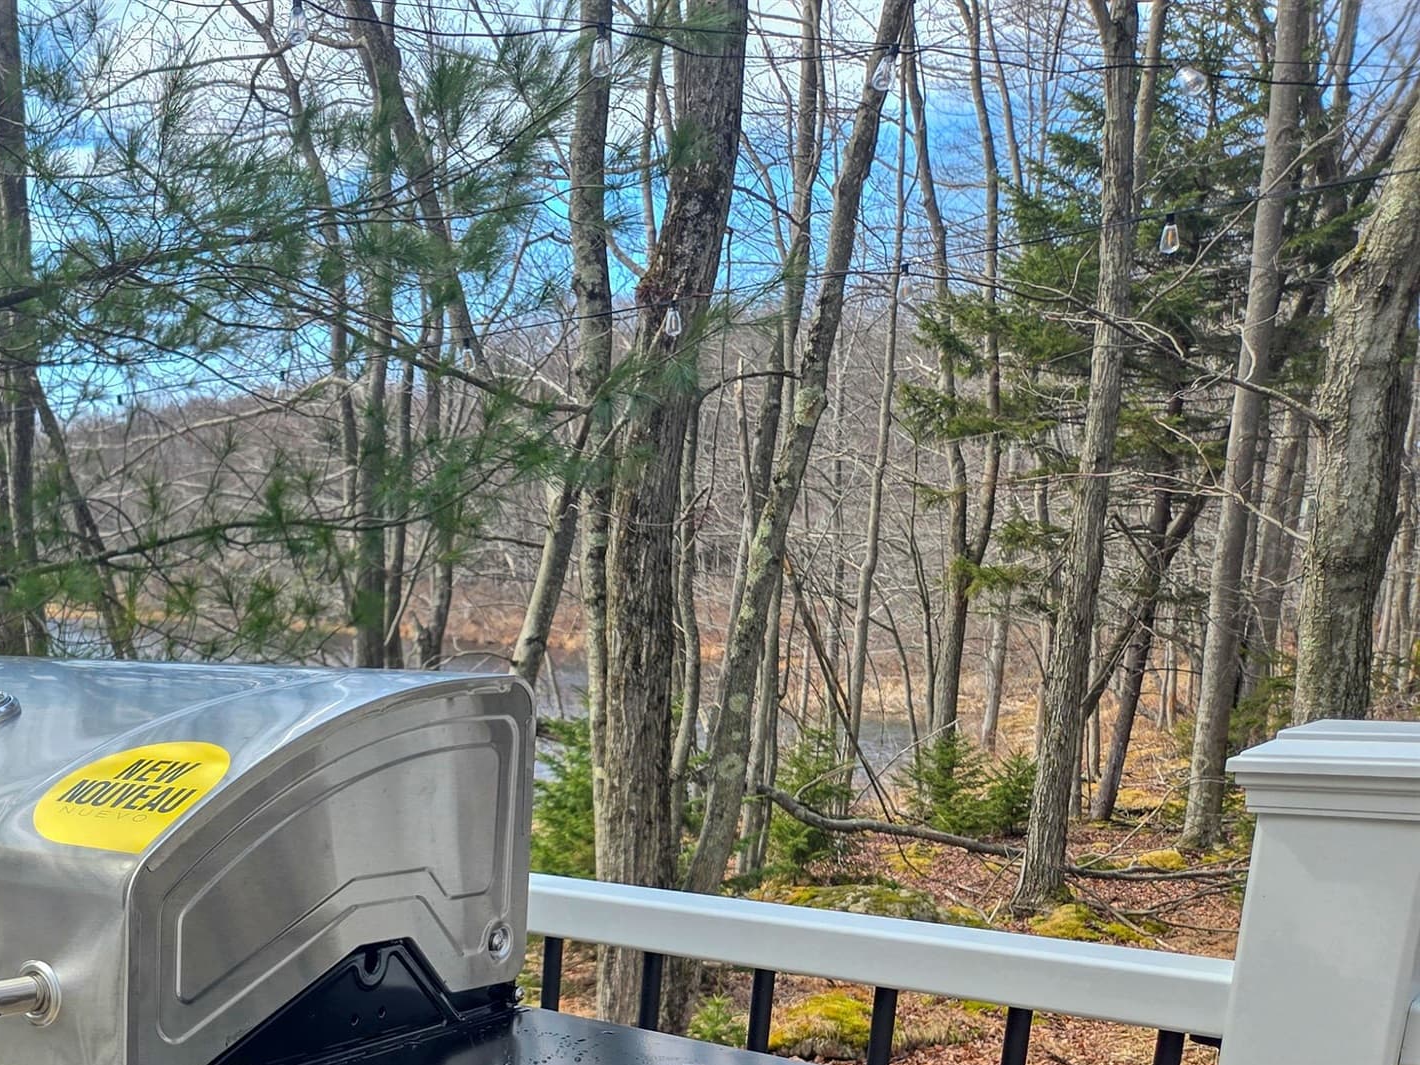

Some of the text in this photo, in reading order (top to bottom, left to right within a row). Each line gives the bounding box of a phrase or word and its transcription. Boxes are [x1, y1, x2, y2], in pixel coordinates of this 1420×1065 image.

[116, 759, 201, 784] NEW
[57, 778, 199, 814] NOUVEAU
[59, 804, 148, 823] NUEVO
